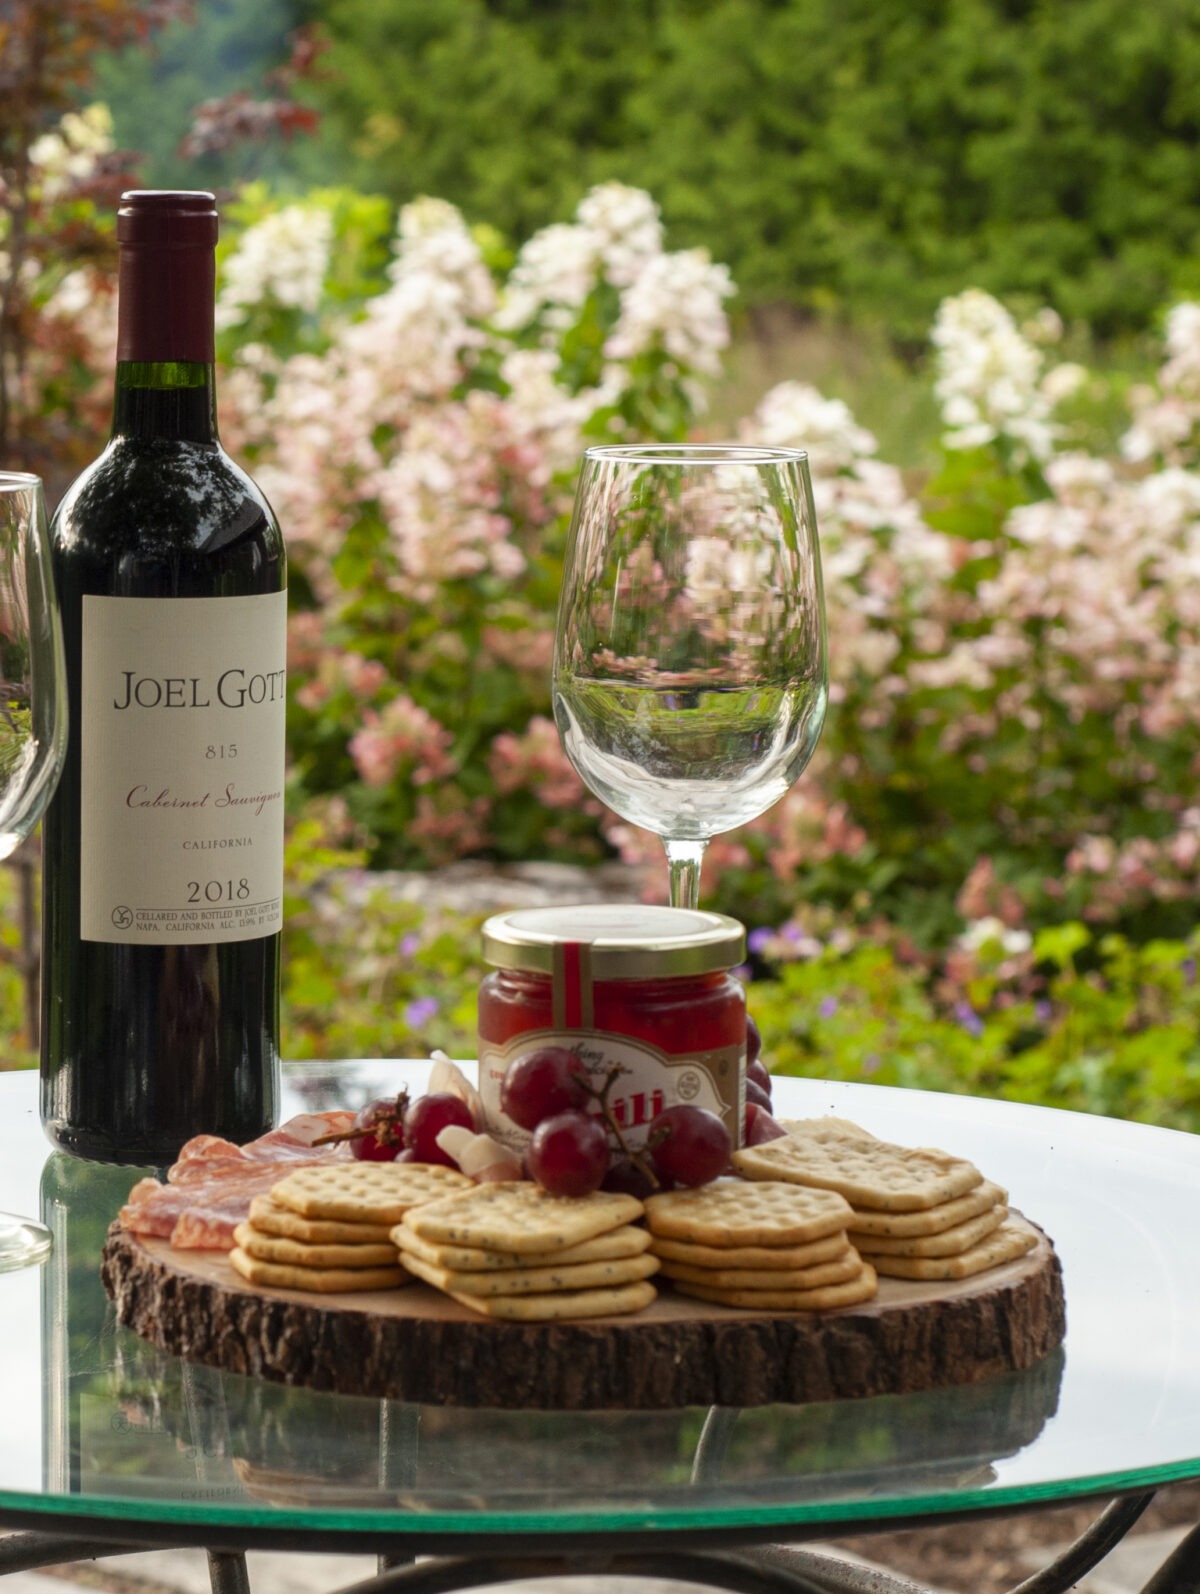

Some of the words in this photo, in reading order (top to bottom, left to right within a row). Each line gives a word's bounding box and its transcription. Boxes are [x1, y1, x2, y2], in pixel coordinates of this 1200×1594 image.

[113, 671, 210, 710] JOEL
[216, 668, 286, 709] GOTT
[205, 743, 238, 760] 815
[126, 784, 211, 809] Cabernet
[182, 837, 254, 850] CALIFORNIA
[186, 878, 250, 903] 2018
[135, 911, 178, 921] CELLARED
[181, 911, 199, 921] AND
[200, 910, 233, 920] BOTTLED
[165, 921, 215, 932] CALIFORNIA
